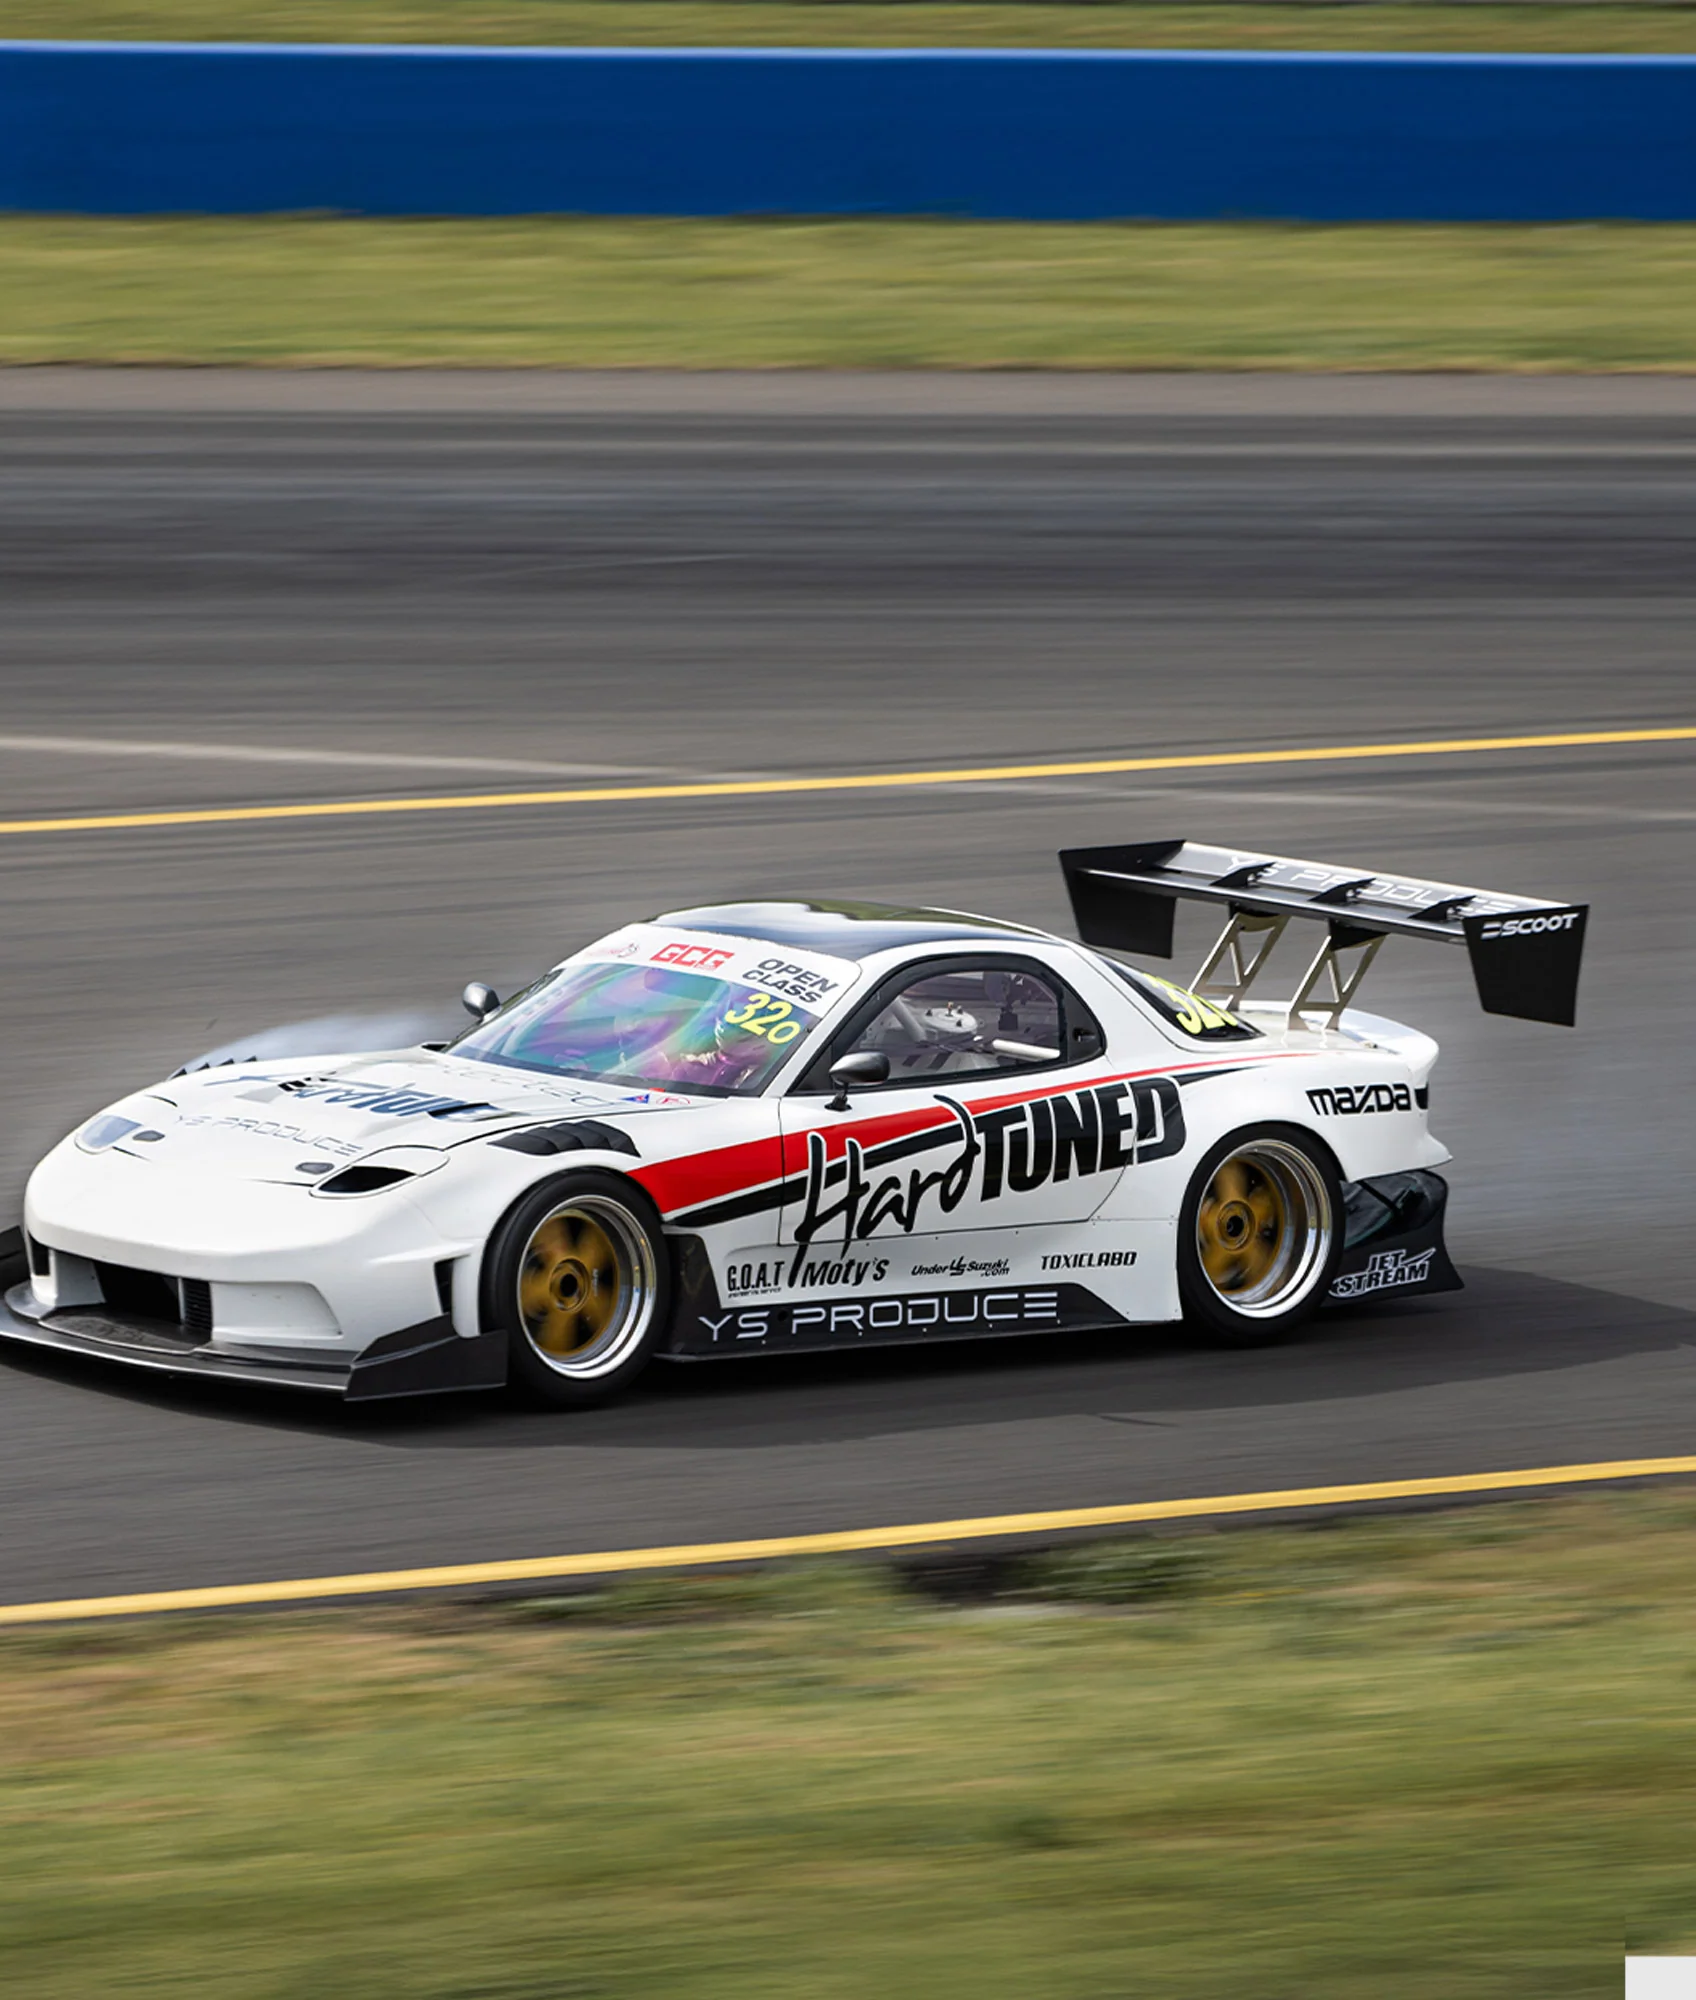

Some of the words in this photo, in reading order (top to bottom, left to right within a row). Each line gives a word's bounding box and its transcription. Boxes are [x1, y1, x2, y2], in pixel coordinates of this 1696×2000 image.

[1500, 912, 1580, 937] SCOOT
[649, 943, 735, 970] GCG
[742, 970, 822, 1003] CLASS
[758, 959, 839, 993] OPEN
[724, 993, 801, 1044] 320
[211, 1116, 364, 1157] PRODUCE
[801, 1257, 890, 1288] Moty's
[1041, 1251, 1137, 1270] TOXICLABO
[1368, 1249, 1407, 1272] JET
[1335, 1261, 1430, 1297] STREAM
[698, 1311, 771, 1342] YS
[791, 1291, 1058, 1335] PRODUCE
